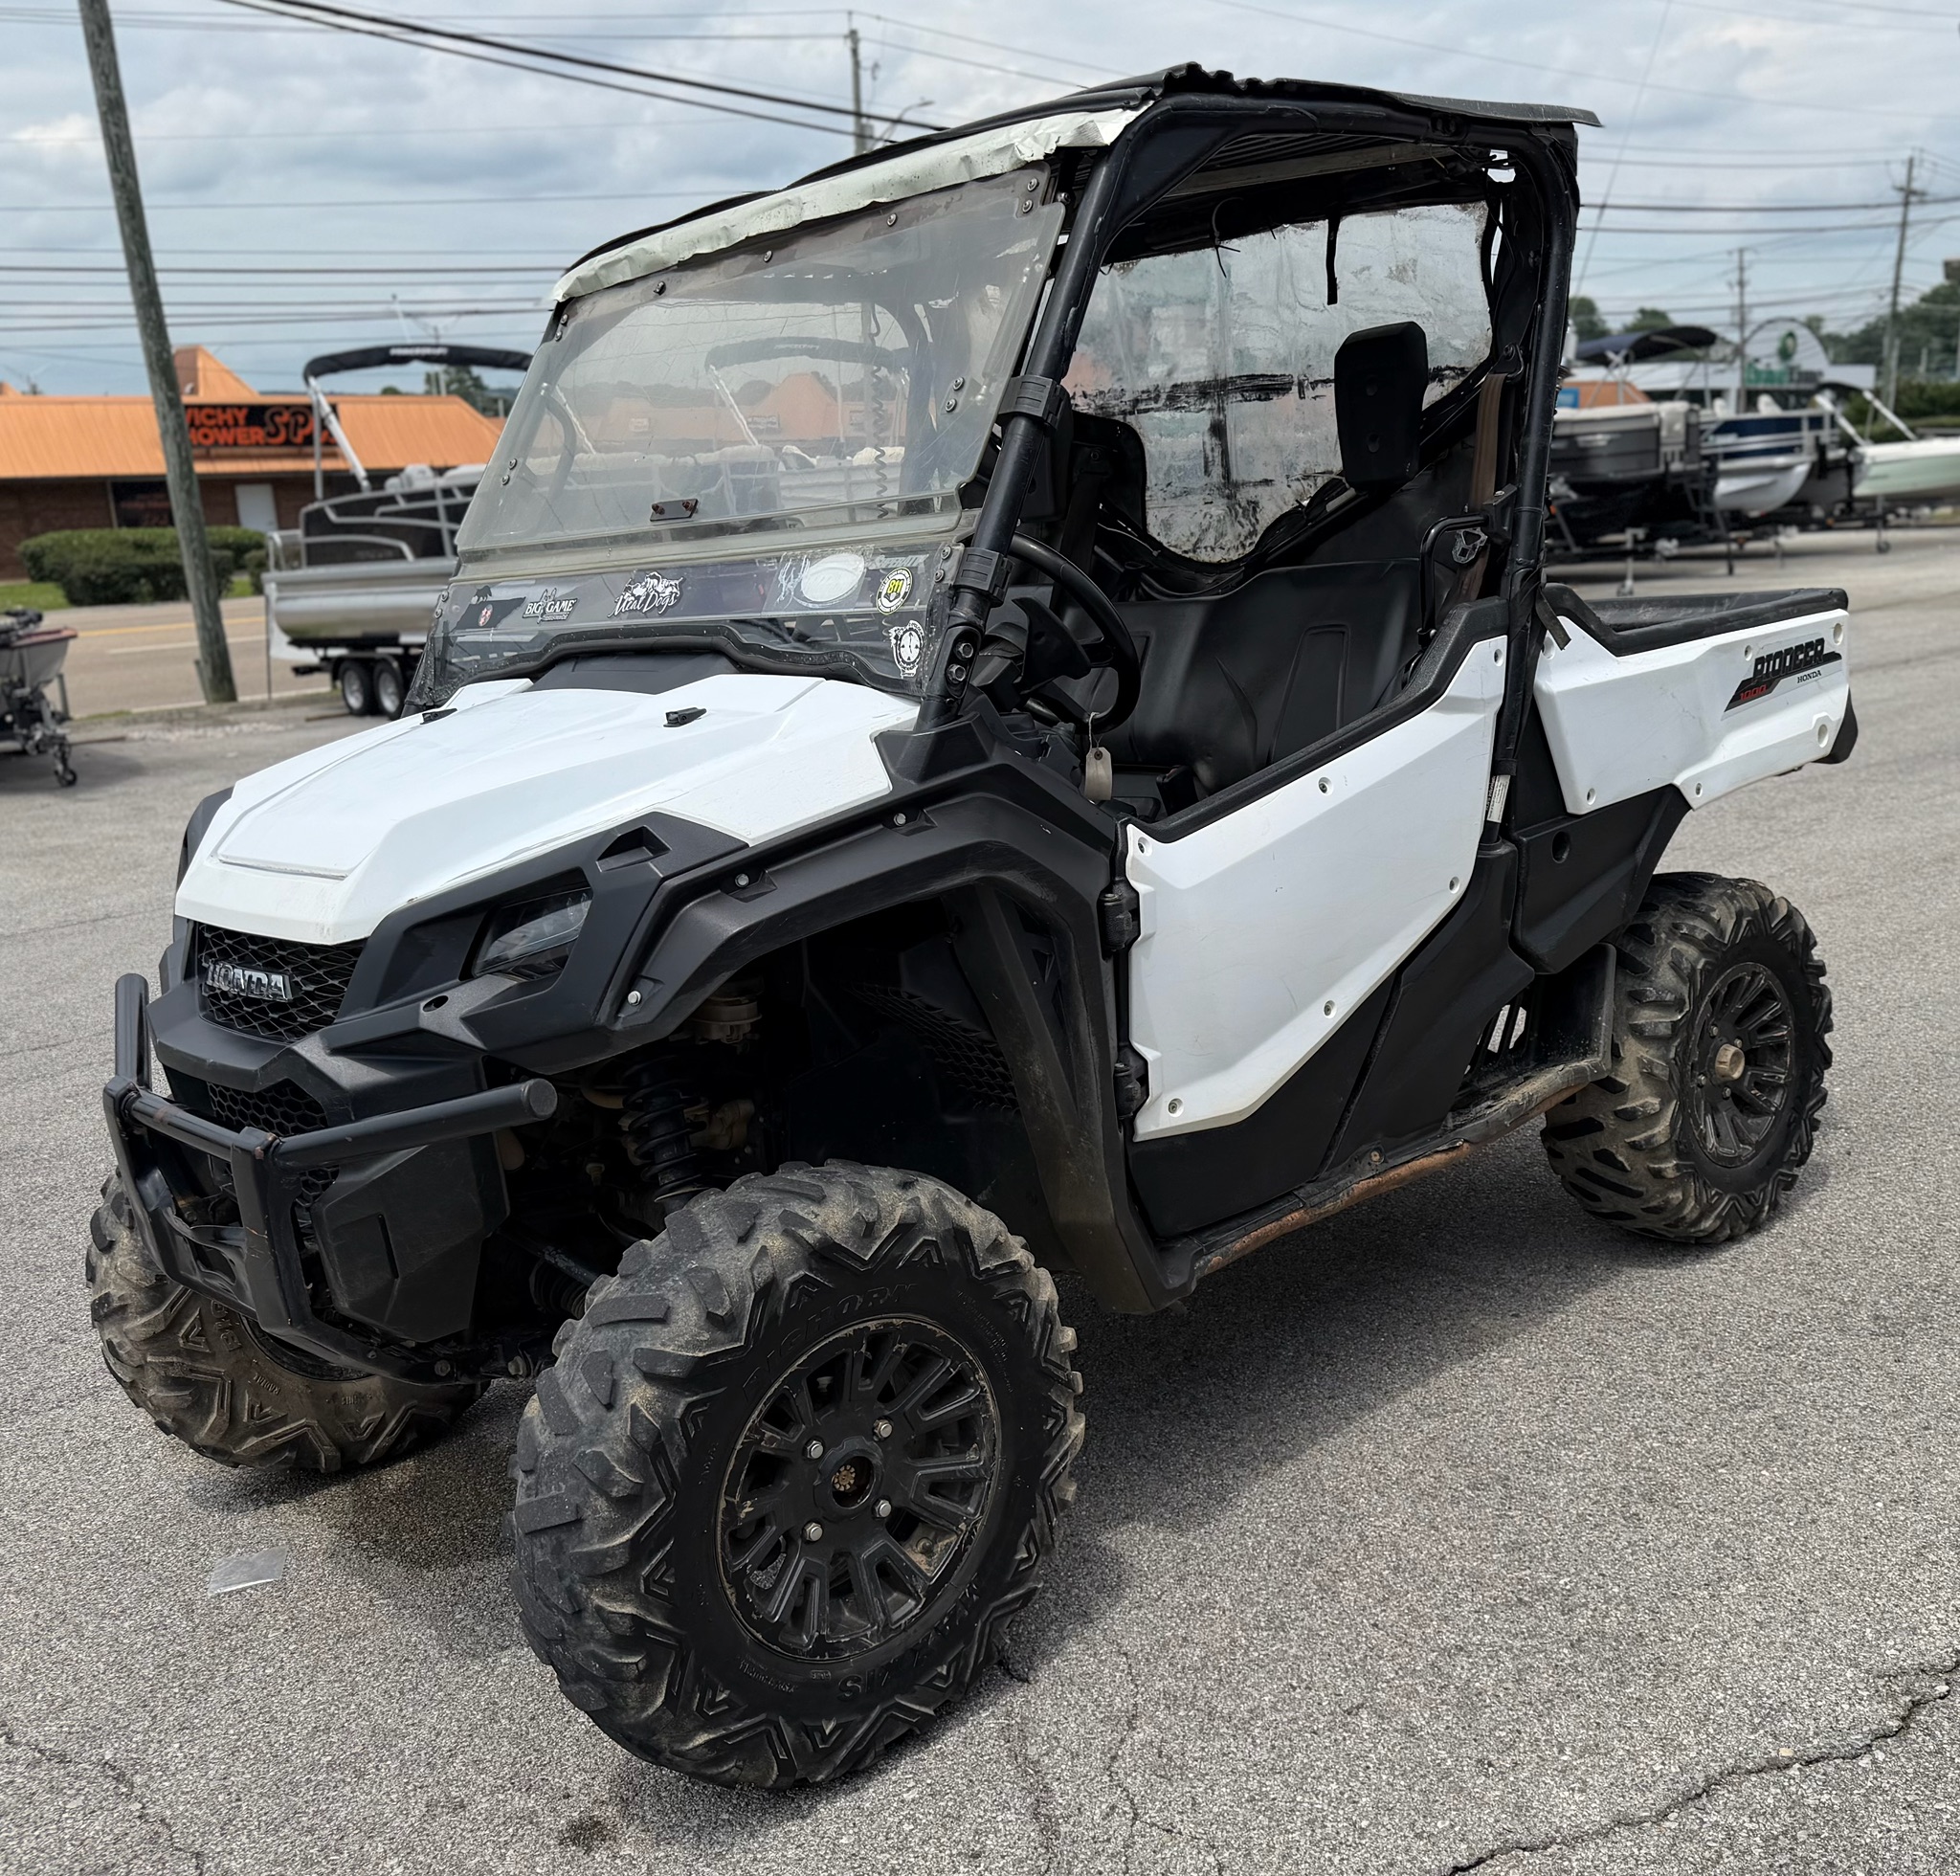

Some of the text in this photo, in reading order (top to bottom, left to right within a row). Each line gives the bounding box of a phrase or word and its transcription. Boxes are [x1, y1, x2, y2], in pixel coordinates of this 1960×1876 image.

[886, 578, 904, 594] 811
[524, 599, 576, 614] BIG GAME
[643, 591, 678, 614] Dogs
[1752, 637, 1825, 681] PIONEER
[1797, 670, 1821, 683] HONDA
[1740, 684, 1767, 701] 1000
[206, 959, 291, 1002] HONDA
